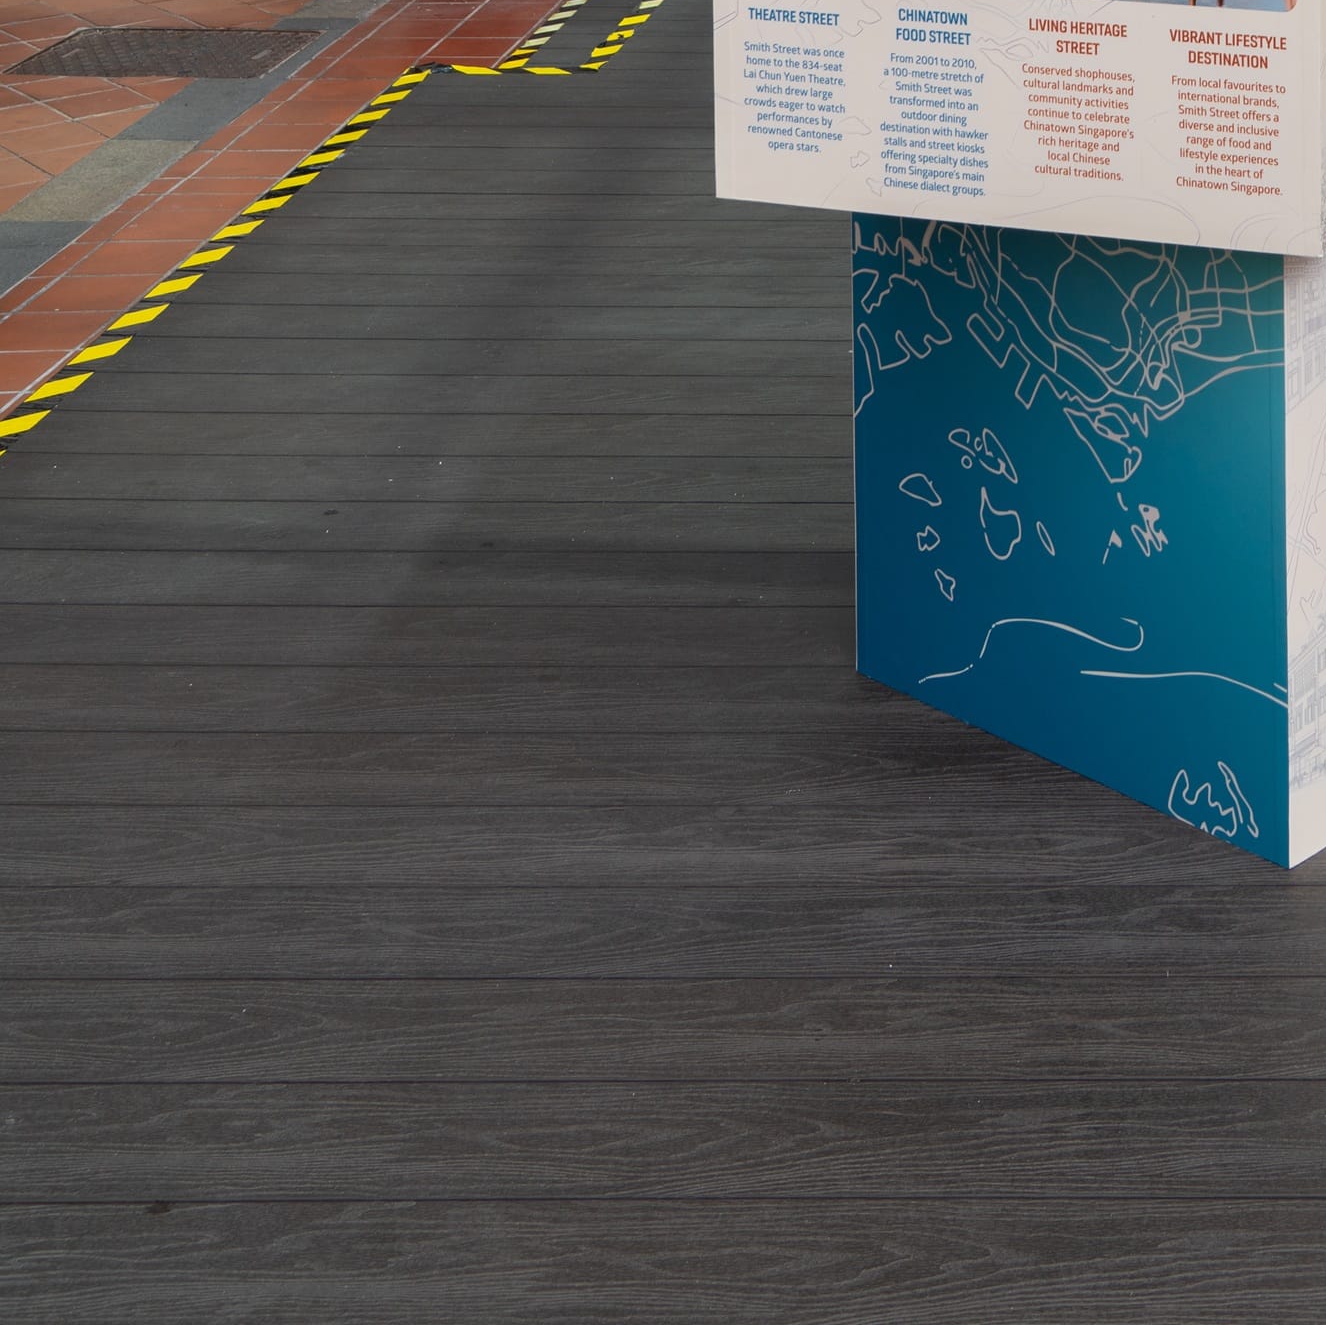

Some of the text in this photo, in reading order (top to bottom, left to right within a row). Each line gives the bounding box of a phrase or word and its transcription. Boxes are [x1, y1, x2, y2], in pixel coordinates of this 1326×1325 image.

[749, 8, 839, 26] THEATRE STREET
[899, 9, 967, 25] CHINATOWN
[897, 28, 970, 45] FOOD STREET
[1030, 18, 1127, 37] LIVING HERITAGE
[1057, 40, 1099, 55] STREET
[1170, 29, 1286, 50] VIBRANT LIFESTYLE
[1189, 51, 1267, 69] DESTINATION
